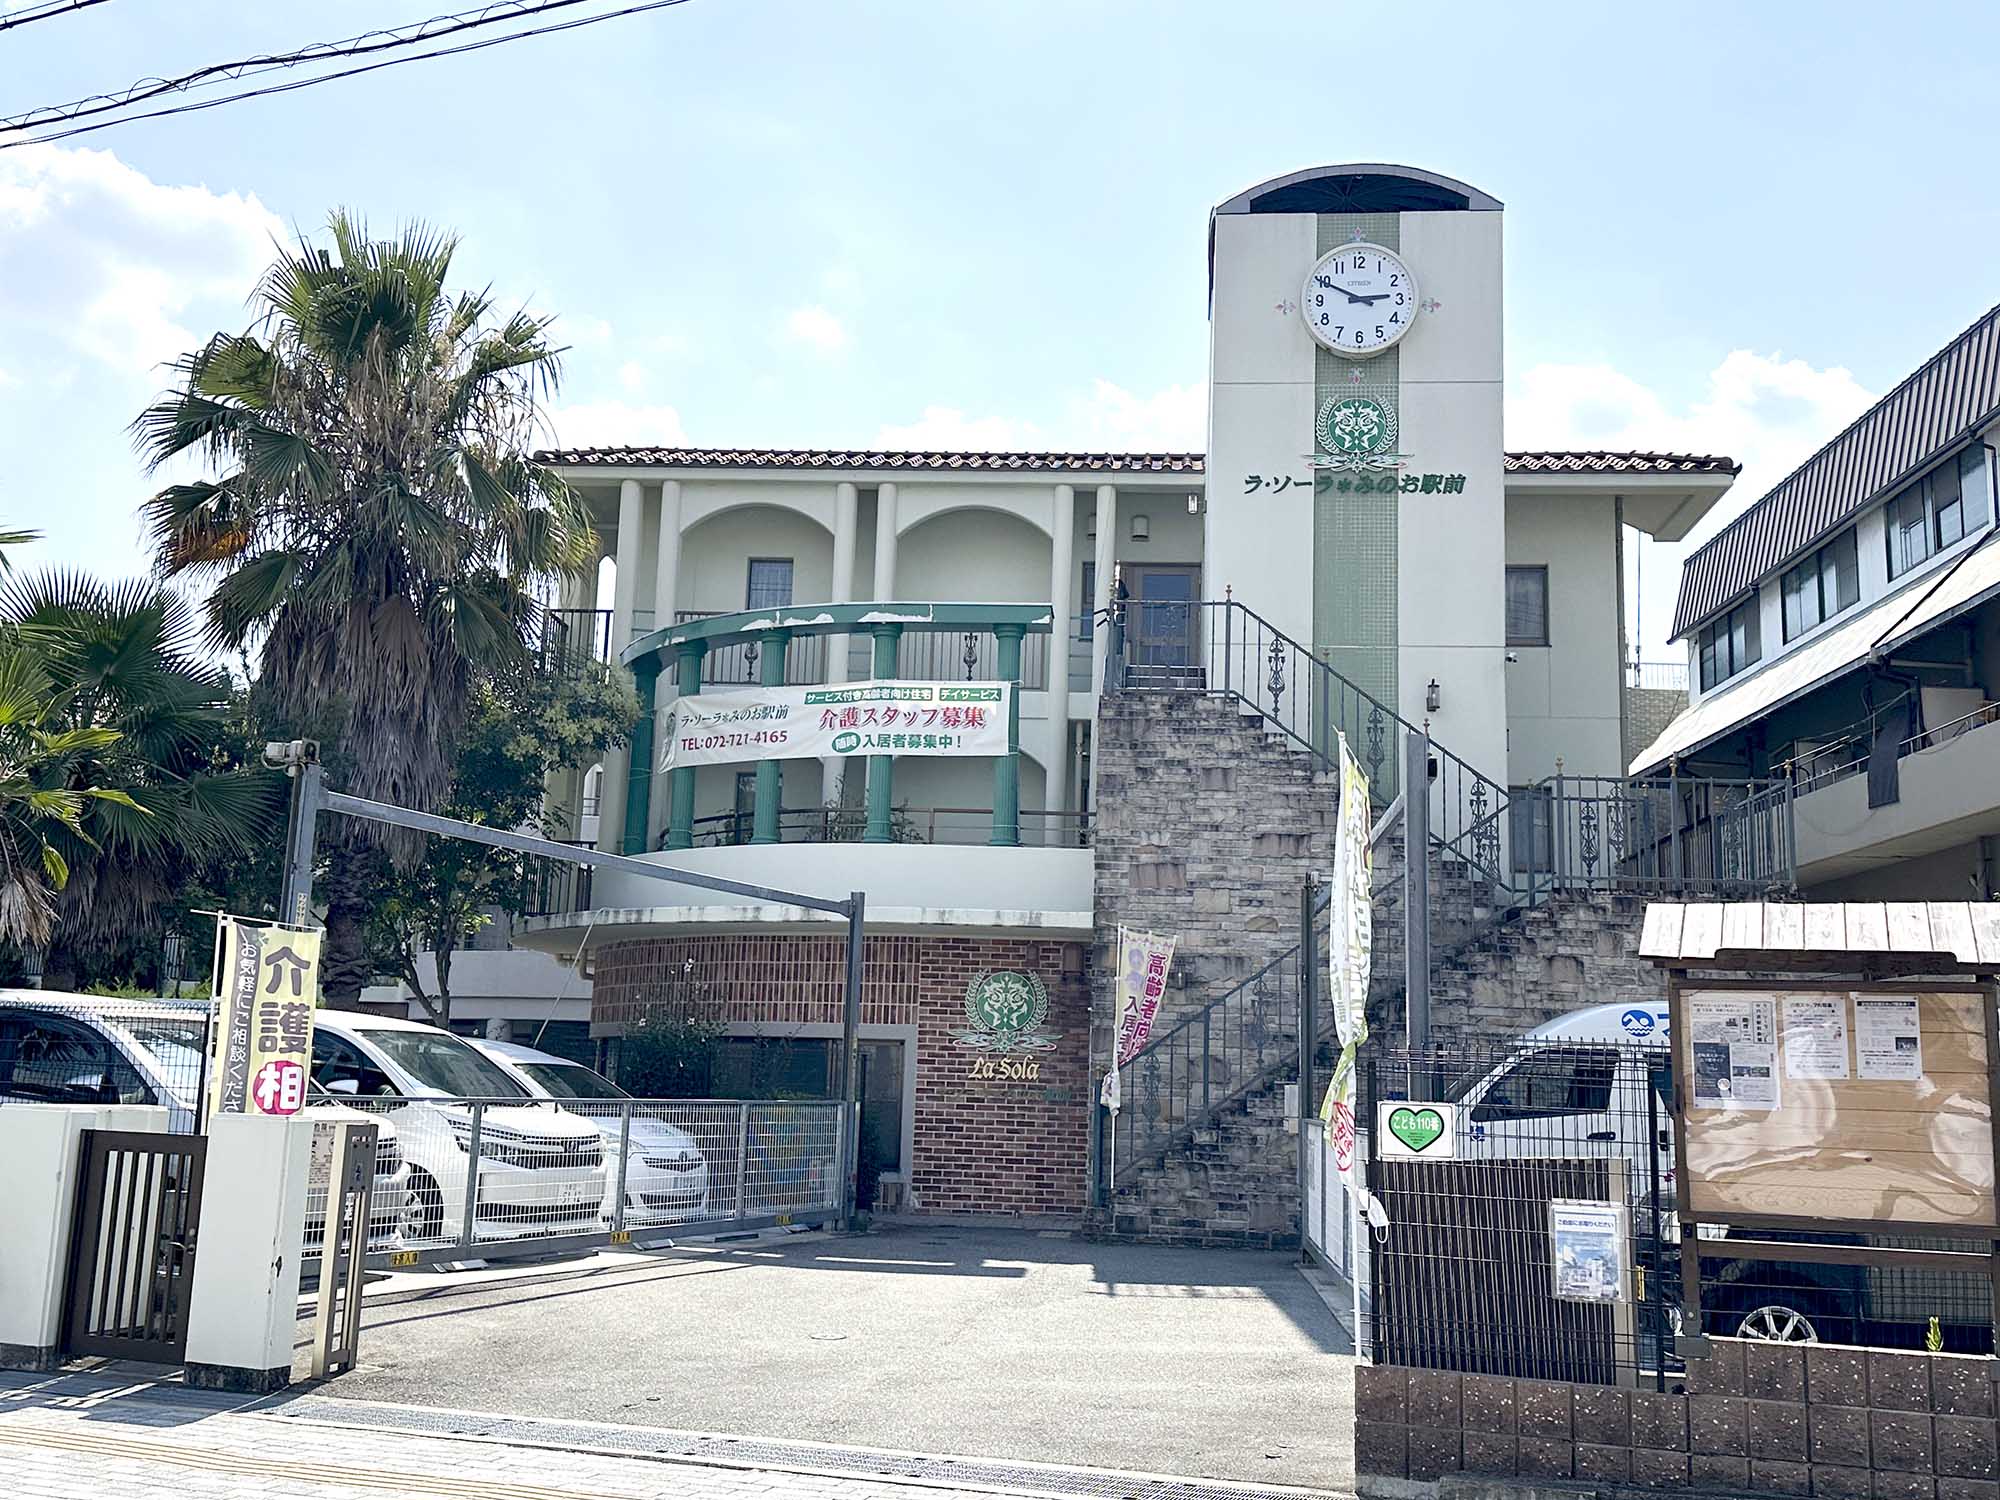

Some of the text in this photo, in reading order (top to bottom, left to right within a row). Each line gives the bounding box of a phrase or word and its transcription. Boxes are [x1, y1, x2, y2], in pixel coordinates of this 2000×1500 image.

[1335, 261, 1345, 275] 11
[1354, 256, 1366, 269] 12
[1378, 260, 1382, 273] 1
[1319, 275, 1331, 288] 10
[1390, 274, 1399, 287] 2
[1315, 294, 1324, 307] 9
[1395, 293, 1405, 306] 3
[1320, 313, 1330, 326] 8
[1389, 312, 1400, 324] 4
[1335, 326, 1345, 339] 7
[1355, 331, 1364, 344] 6
[1375, 325, 1384, 338] 5
[806, 688, 932, 704] サービス付き高齢者向け住宅
[940, 688, 1000, 700] デイサービス
[818, 705, 986, 730] 介護スタッフ募集
[681, 730, 788, 751] TEL:072-721-4165
[968, 1055, 1041, 1080] La Sola
[1393, 1115, 1440, 1131] こども110番
